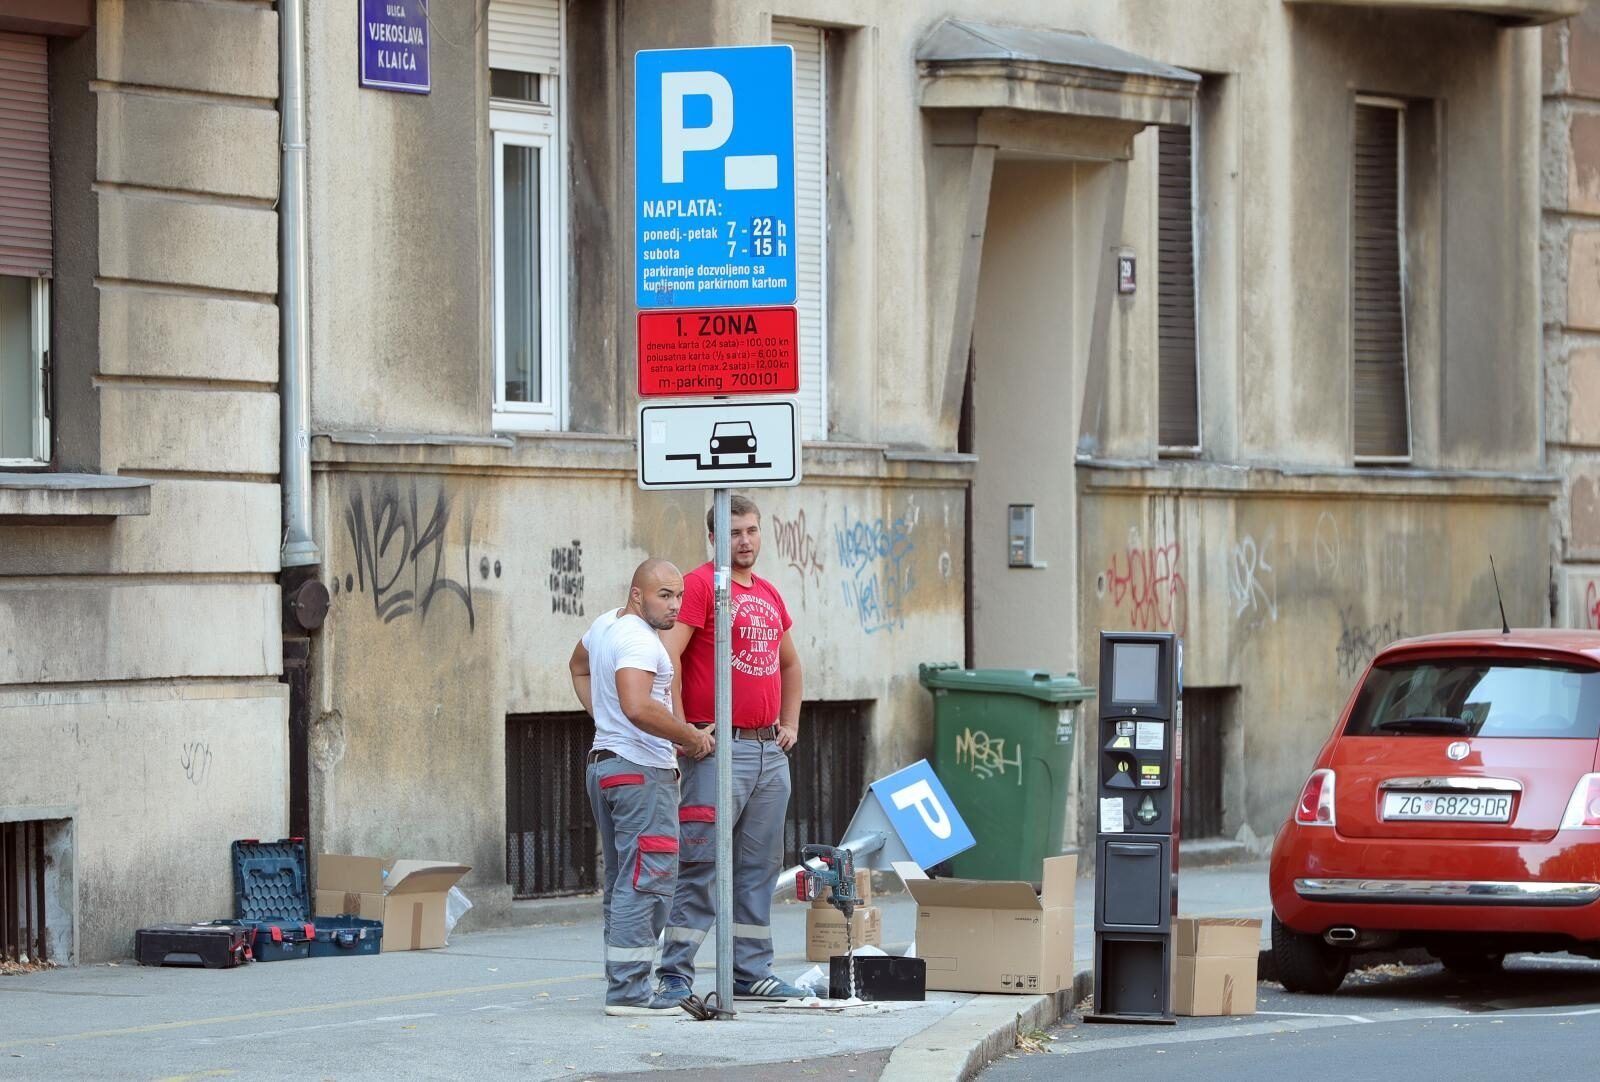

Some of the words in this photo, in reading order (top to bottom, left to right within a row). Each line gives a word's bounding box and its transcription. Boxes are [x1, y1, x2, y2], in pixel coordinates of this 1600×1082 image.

[386, 4, 406, 18] ULICA
[368, 22, 424, 45] VJEKOSLAVA
[378, 48, 416, 71] KLAIĆA
[661, 71, 734, 183] P
[643, 199, 722, 218] NAPLATA:
[727, 221, 737, 238] 7
[753, 218, 772, 236] 22
[777, 220, 787, 237] h
[643, 248, 680, 260] subota
[727, 241, 737, 258] 7
[754, 238, 772, 256] 15
[777, 240, 787, 257] h
[643, 265, 694, 279] parkiranje
[697, 264, 750, 278] dozvoljeno
[753, 265, 765, 275] sa
[643, 279, 695, 293] kupljenom
[698, 278, 749, 292] parkirnom
[752, 277, 787, 289] kartom
[676, 316, 688, 337] 1.
[698, 314, 758, 336] ZONA
[646, 341, 676, 351] dnevna
[678, 341, 700, 350] karta
[702, 339, 716, 350] (24
[779, 337, 789, 346] kn
[646, 352, 687, 364] polusatna
[688, 351, 711, 360] karta
[779, 348, 789, 357] kn
[650, 364, 673, 373] satna
[675, 363, 697, 372] karta
[658, 374, 723, 391] m-parking
[731, 372, 779, 387] 700101
[739, 627, 779, 641] VINTAGE
[890, 778, 952, 840] P
[1399, 796, 1422, 814] ZG
